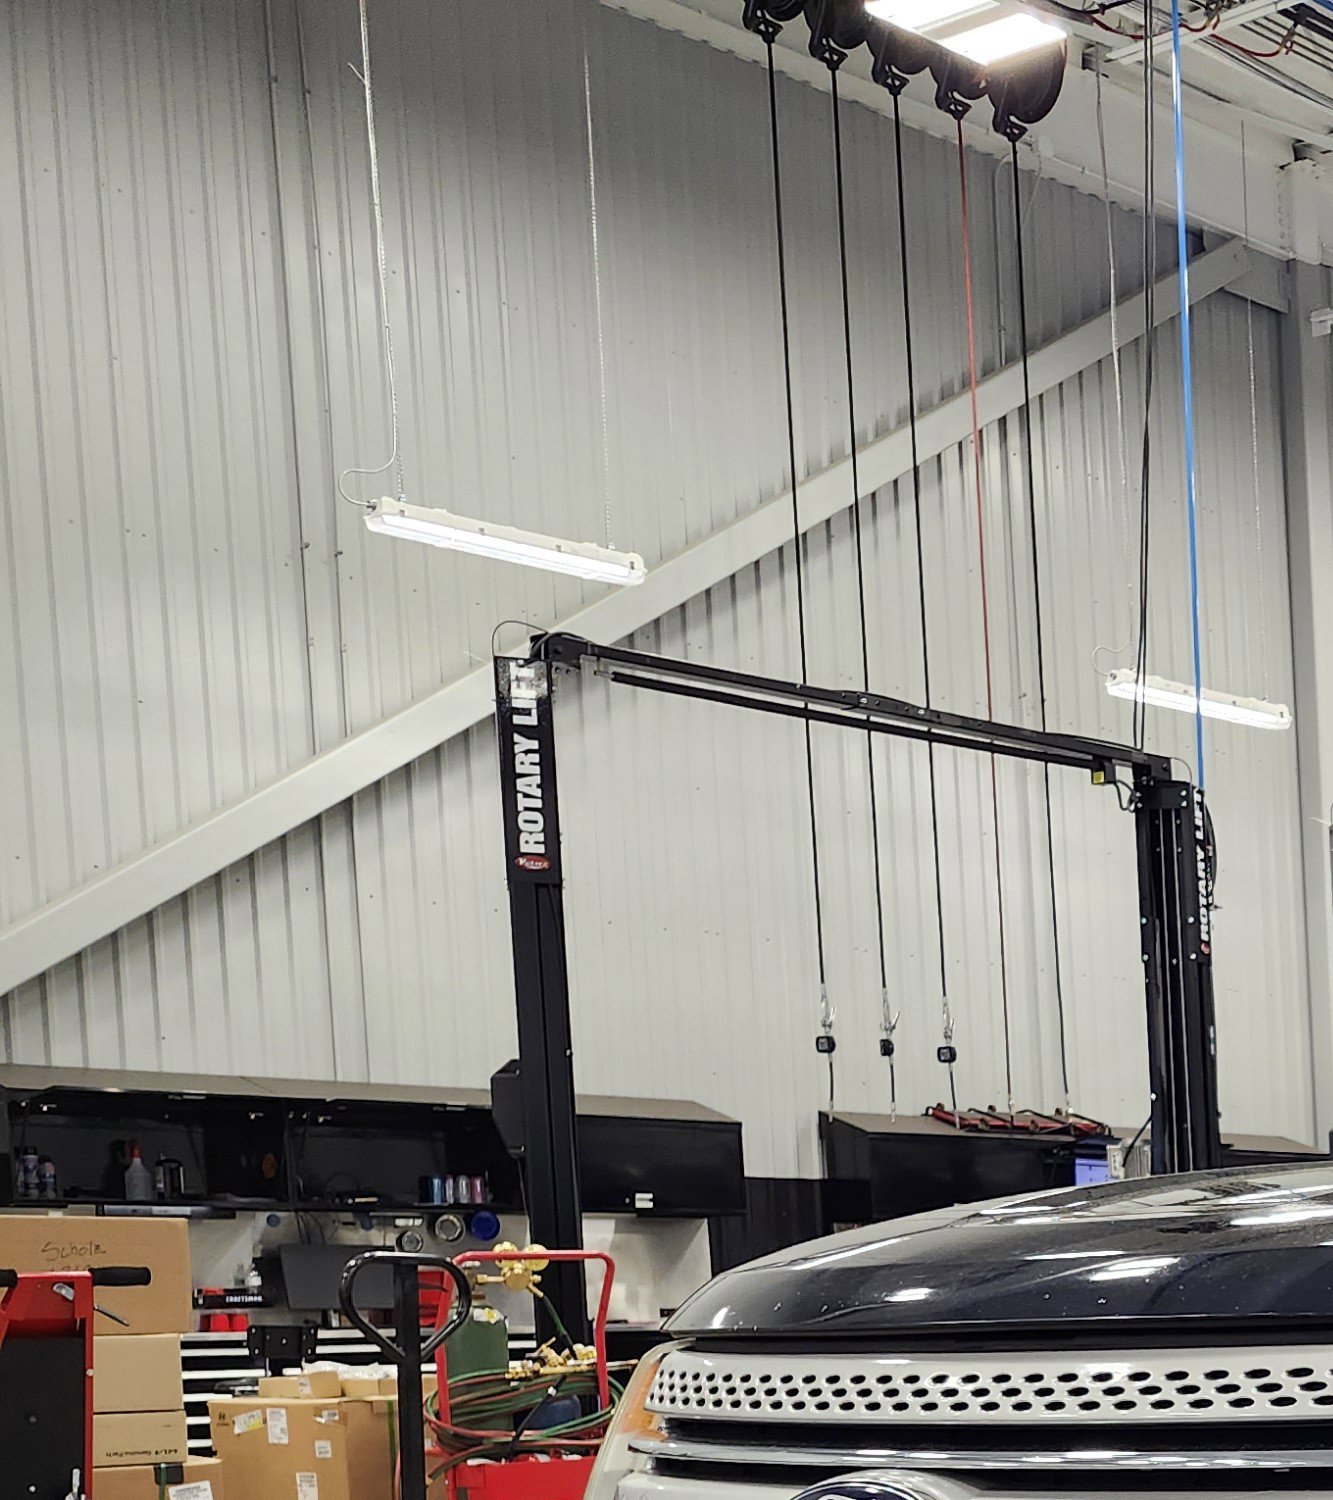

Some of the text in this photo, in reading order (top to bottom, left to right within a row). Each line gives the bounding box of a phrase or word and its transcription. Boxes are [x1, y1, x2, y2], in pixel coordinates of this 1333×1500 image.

[510, 660, 539, 727] LIFT
[513, 732, 546, 855] ROTARY
[1193, 788, 1204, 841] LIFT
[1196, 845, 1209, 942] ROTARY
